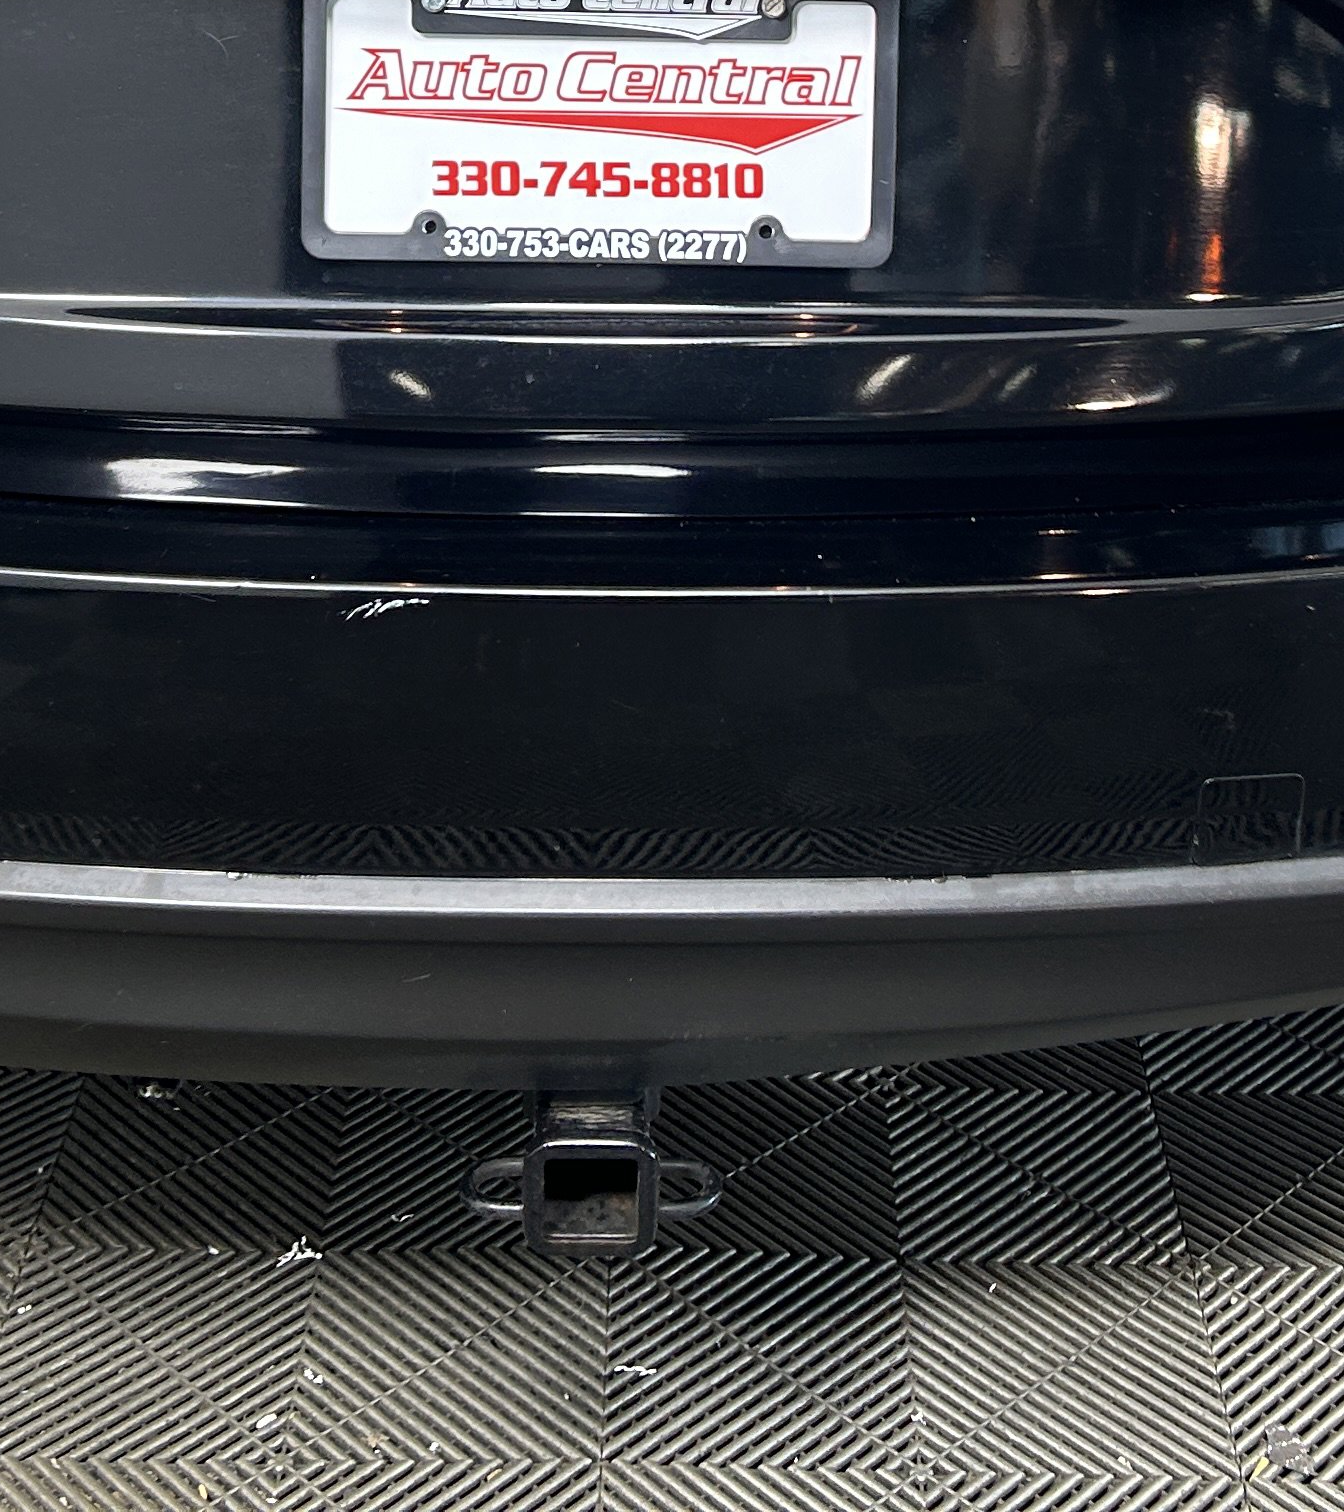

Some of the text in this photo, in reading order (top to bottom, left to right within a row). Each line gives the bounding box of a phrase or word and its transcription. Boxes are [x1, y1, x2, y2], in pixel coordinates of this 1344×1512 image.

[347, 48, 862, 107] Auto Central
[432, 160, 764, 199] 330-745-8810
[443, 228, 748, 263] 330-753-CARS (2277)
